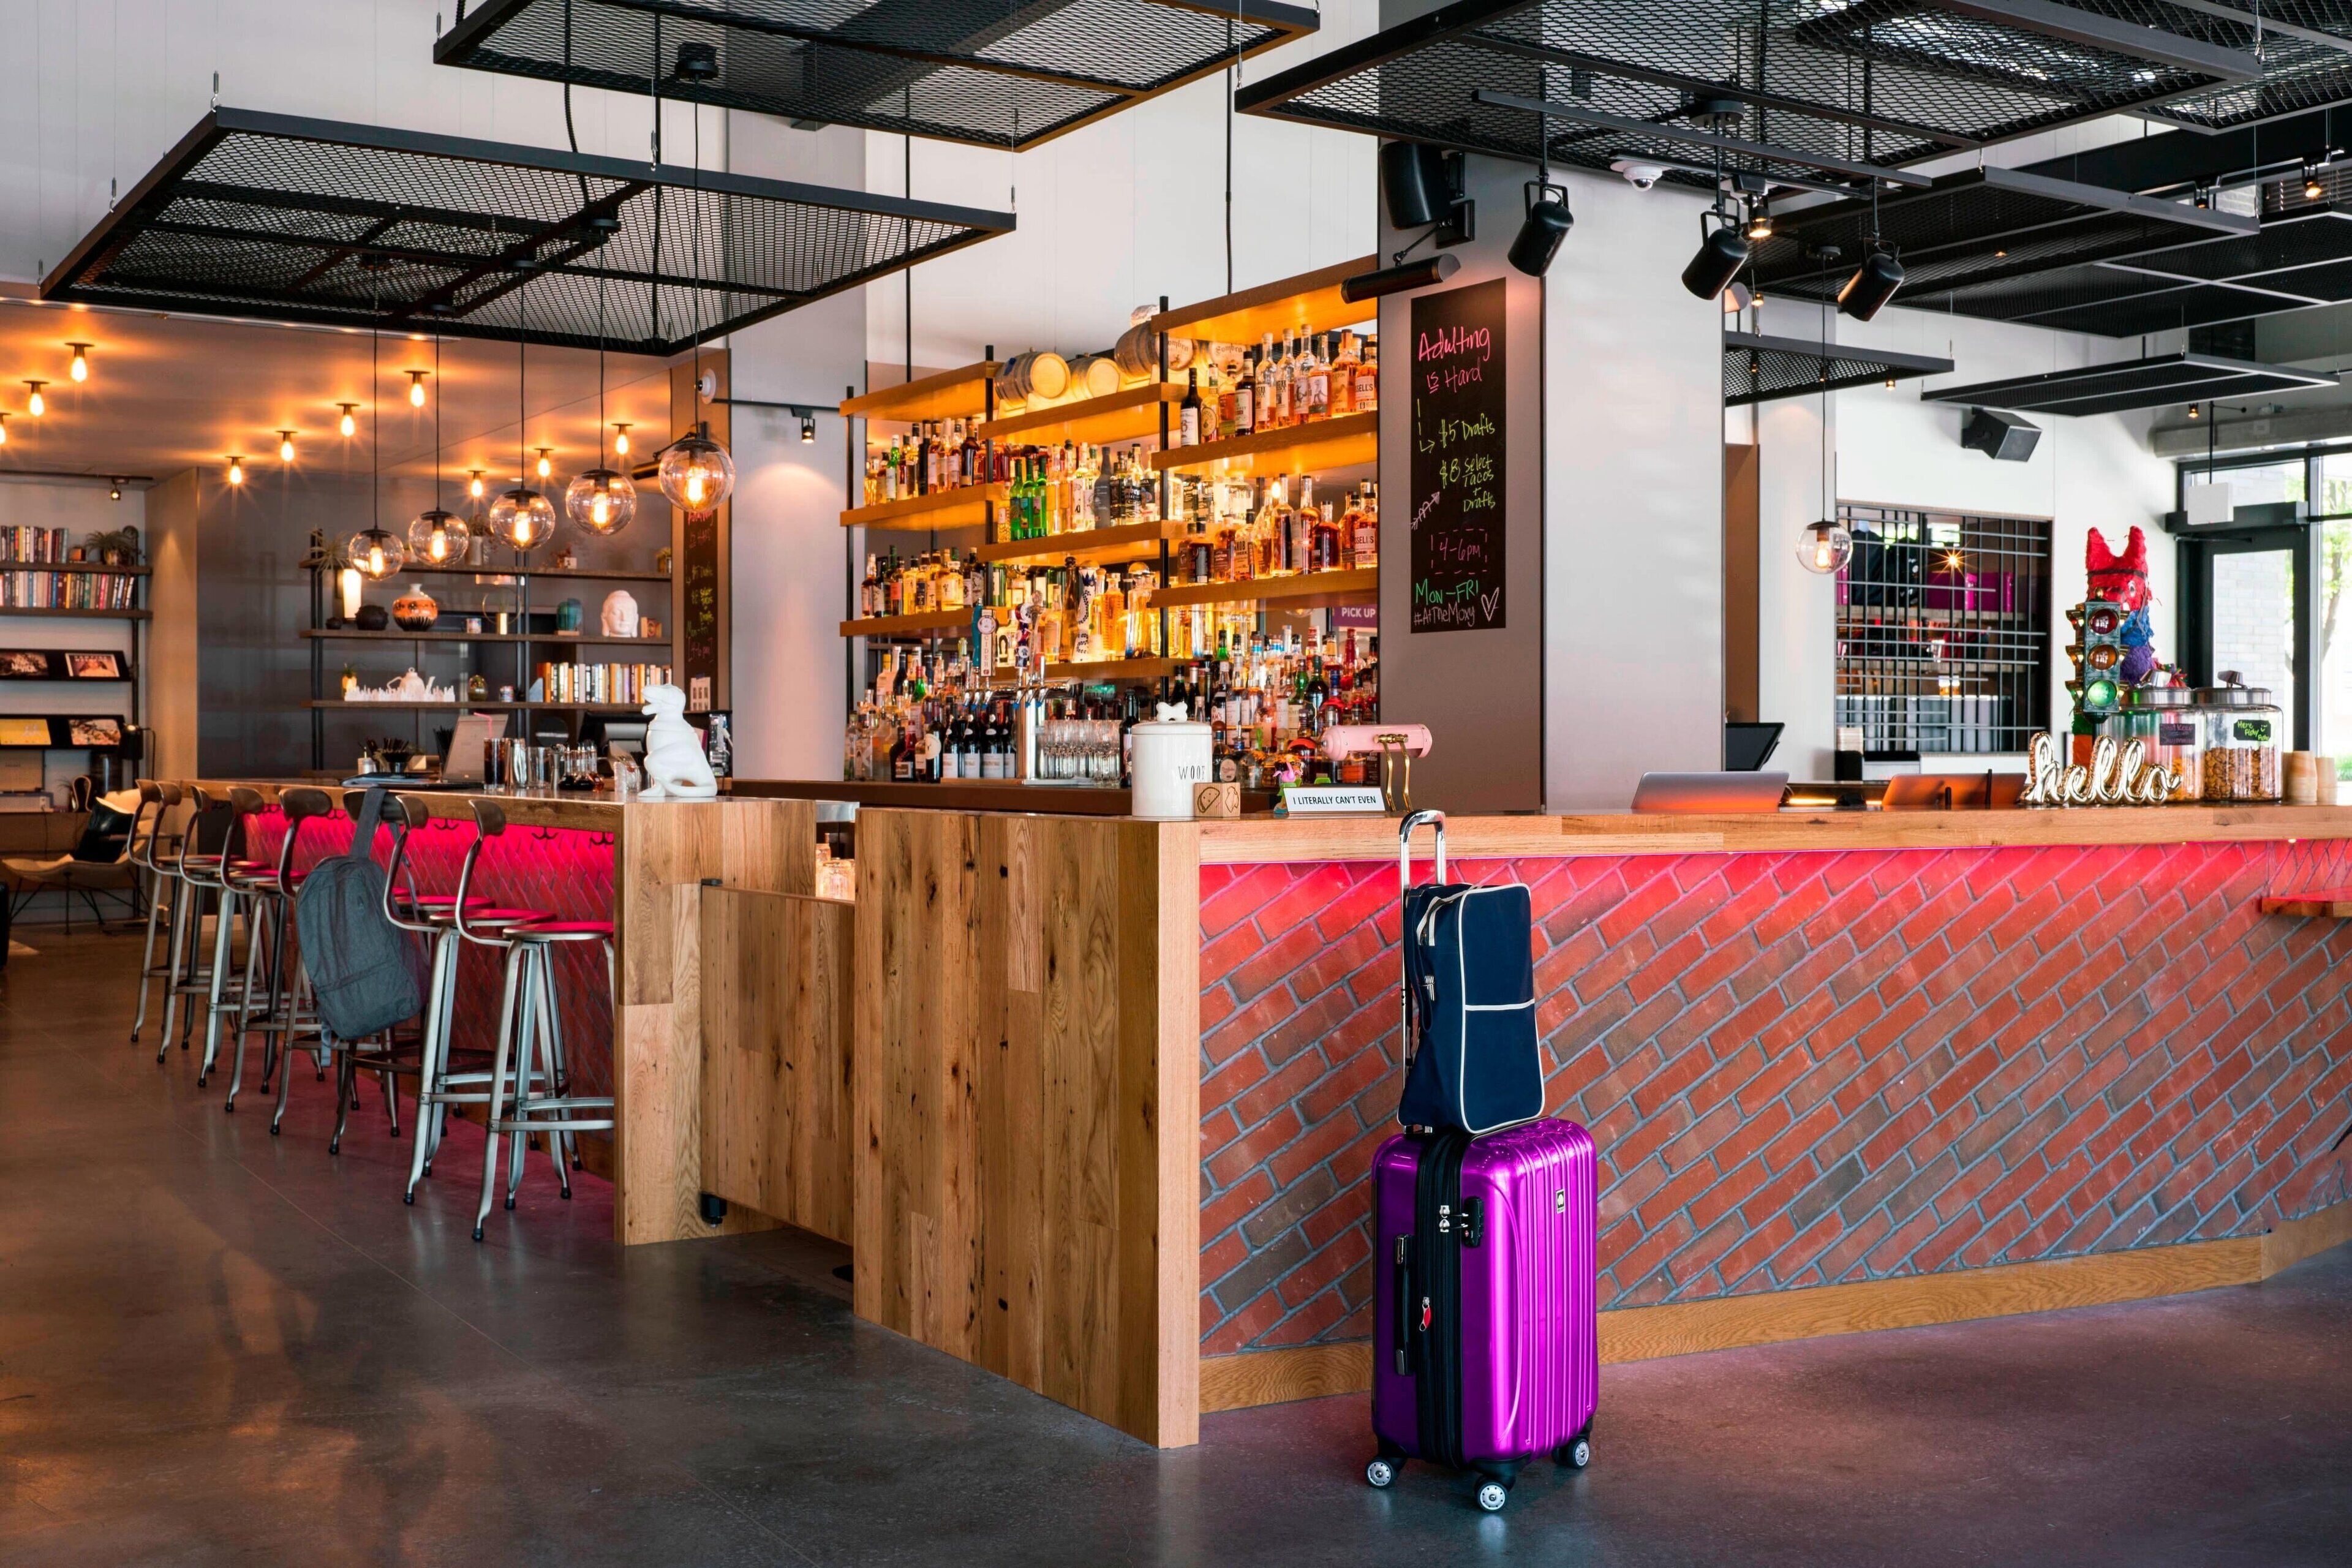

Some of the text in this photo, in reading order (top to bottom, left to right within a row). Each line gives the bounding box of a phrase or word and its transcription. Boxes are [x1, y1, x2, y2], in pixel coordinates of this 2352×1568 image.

[1419, 326, 1490, 361] Adulting
[1445, 356, 1482, 393] Hard
[1438, 412, 1495, 448] $5 Drafts
[1439, 458, 1461, 489] $8
[1463, 490, 1496, 513] Drafts
[1341, 607, 1376, 618] PICK UP
[1178, 765, 1205, 780] WOOF
[2020, 731, 2182, 806] hello
[1298, 796, 1333, 805] LITERALLY
[1335, 796, 1355, 804] CAN'T
